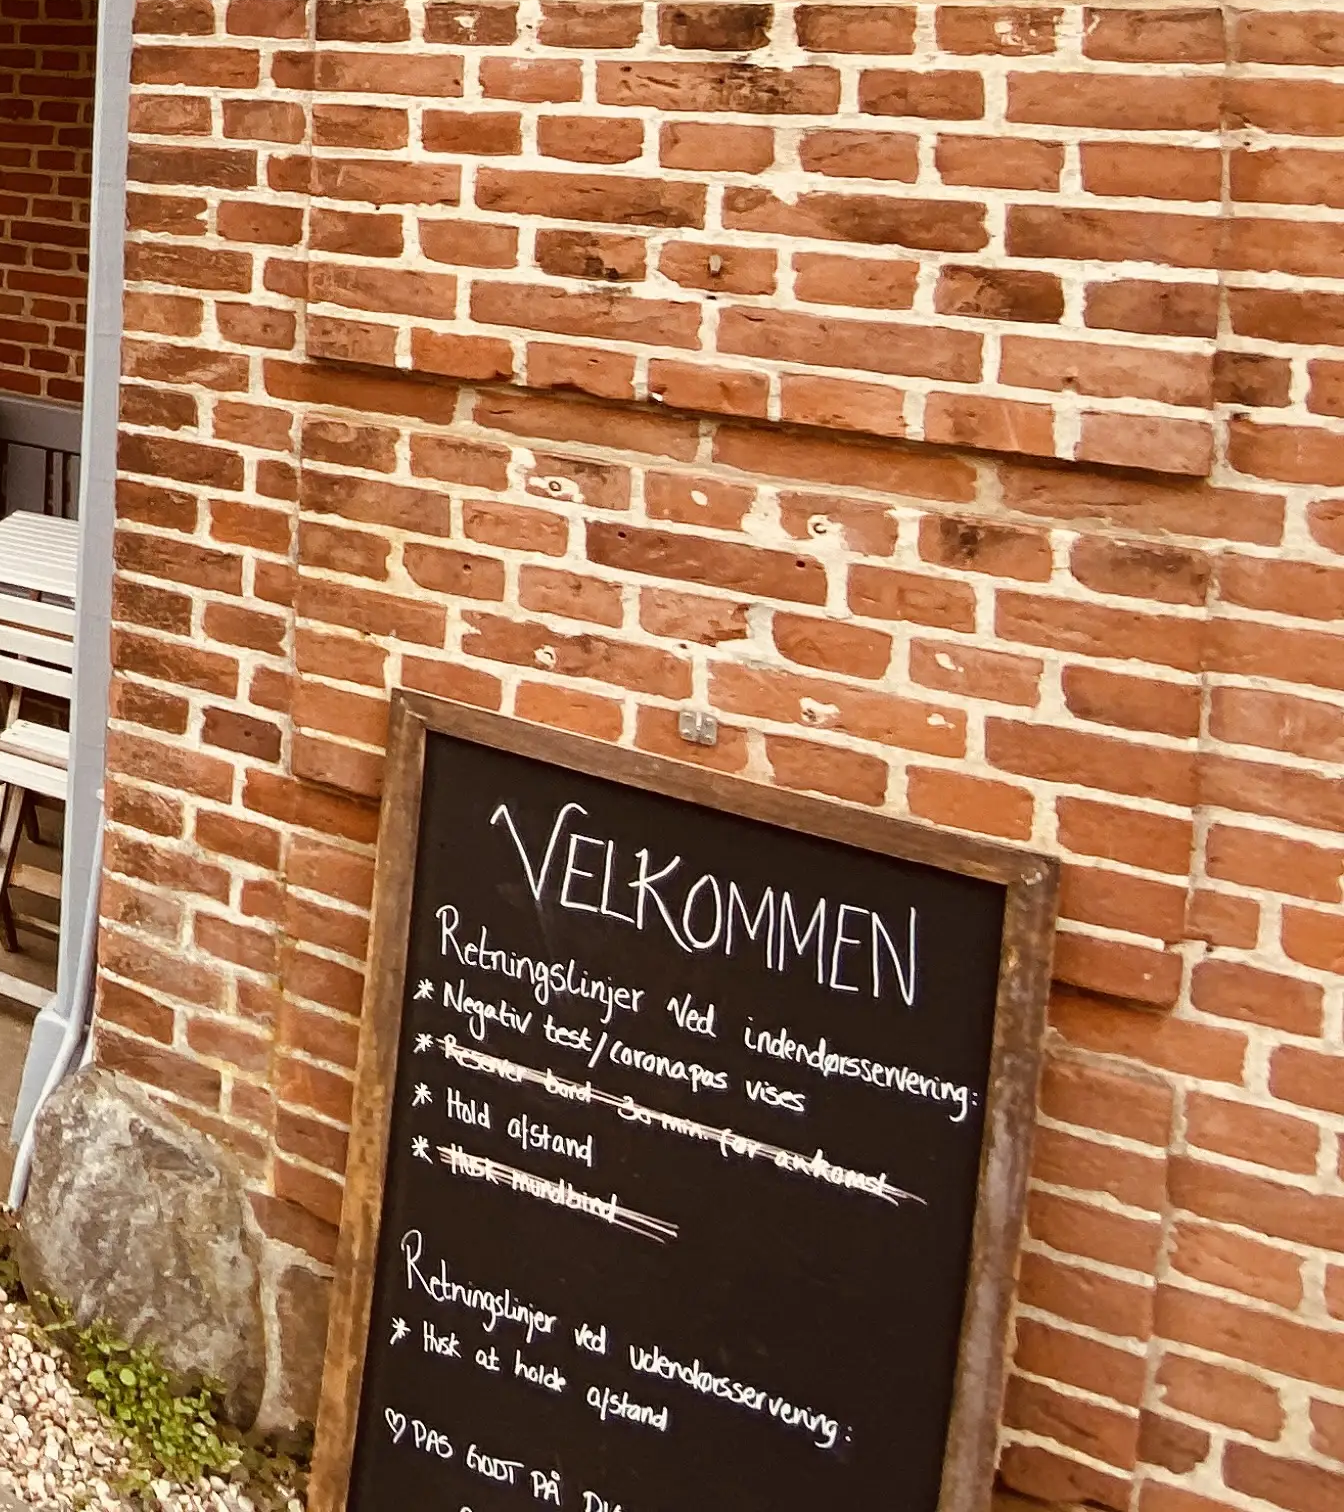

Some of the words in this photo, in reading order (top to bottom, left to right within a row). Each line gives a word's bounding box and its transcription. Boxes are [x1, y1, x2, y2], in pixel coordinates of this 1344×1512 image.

[488, 801, 918, 1007] VELKOMMEN
[434, 903, 646, 1025] Retningslinjer
[442, 978, 533, 1042] Negativ
[446, 1086, 491, 1130] Hold
[400, 1228, 559, 1345] Retningslinjer
[422, 1320, 463, 1360] Husk
[474, 1346, 502, 1373] at
[514, 1349, 568, 1394] holde
[411, 1418, 455, 1459] PAS
[465, 1443, 525, 1485] GODT
[529, 1470, 561, 1506] PÅ
